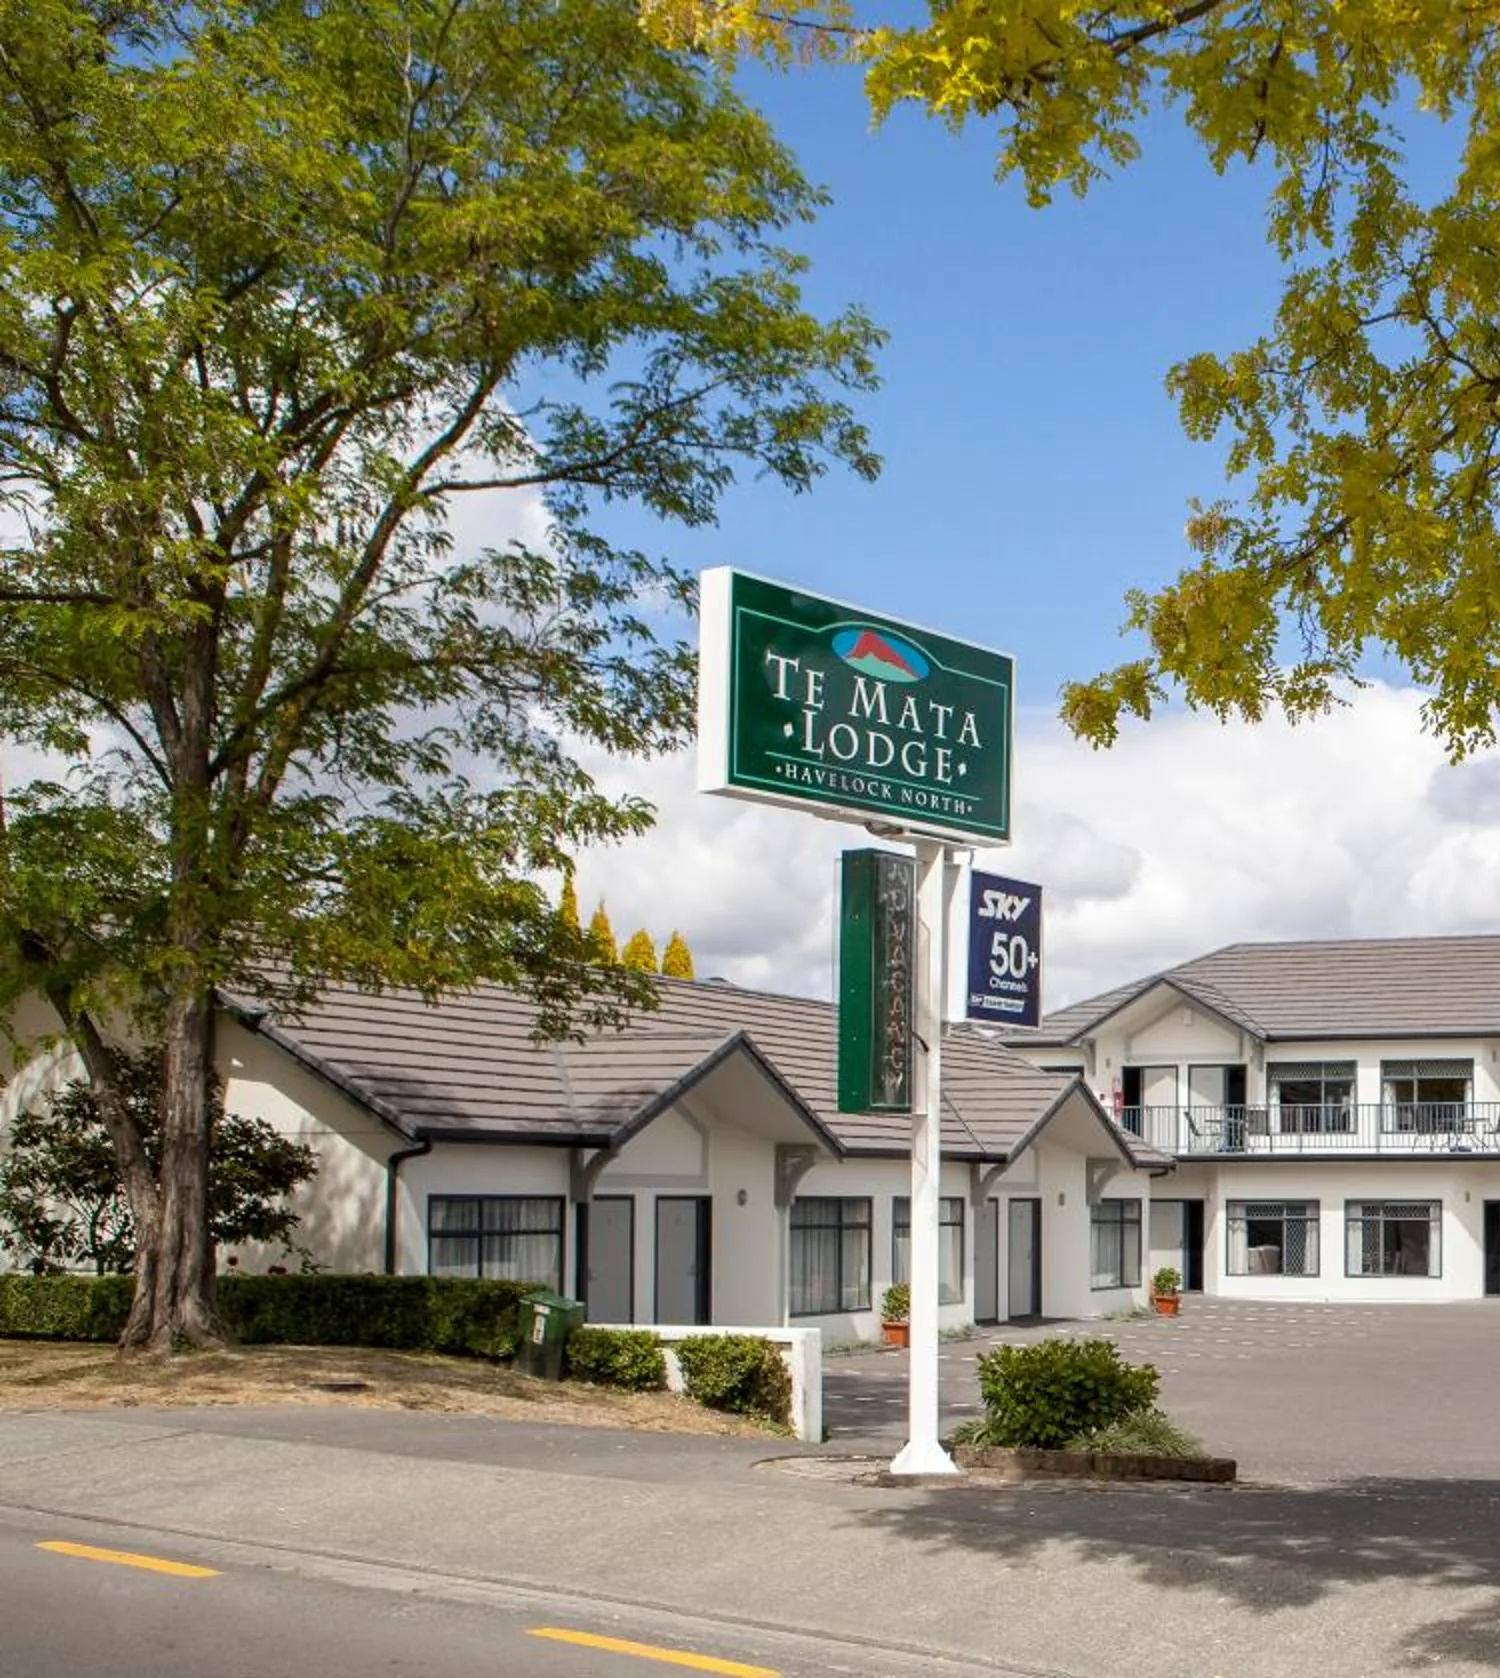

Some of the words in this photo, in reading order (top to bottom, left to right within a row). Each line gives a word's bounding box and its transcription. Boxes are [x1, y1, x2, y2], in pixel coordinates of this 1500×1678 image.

[765, 649, 826, 709] TE
[848, 675, 983, 749] MATA
[802, 709, 953, 785] LODGE
[784, 763, 893, 800] HAVELOCK
[901, 780, 967, 816] NORTH
[977, 889, 1030, 922] SKY
[989, 931, 1038, 979] 50+
